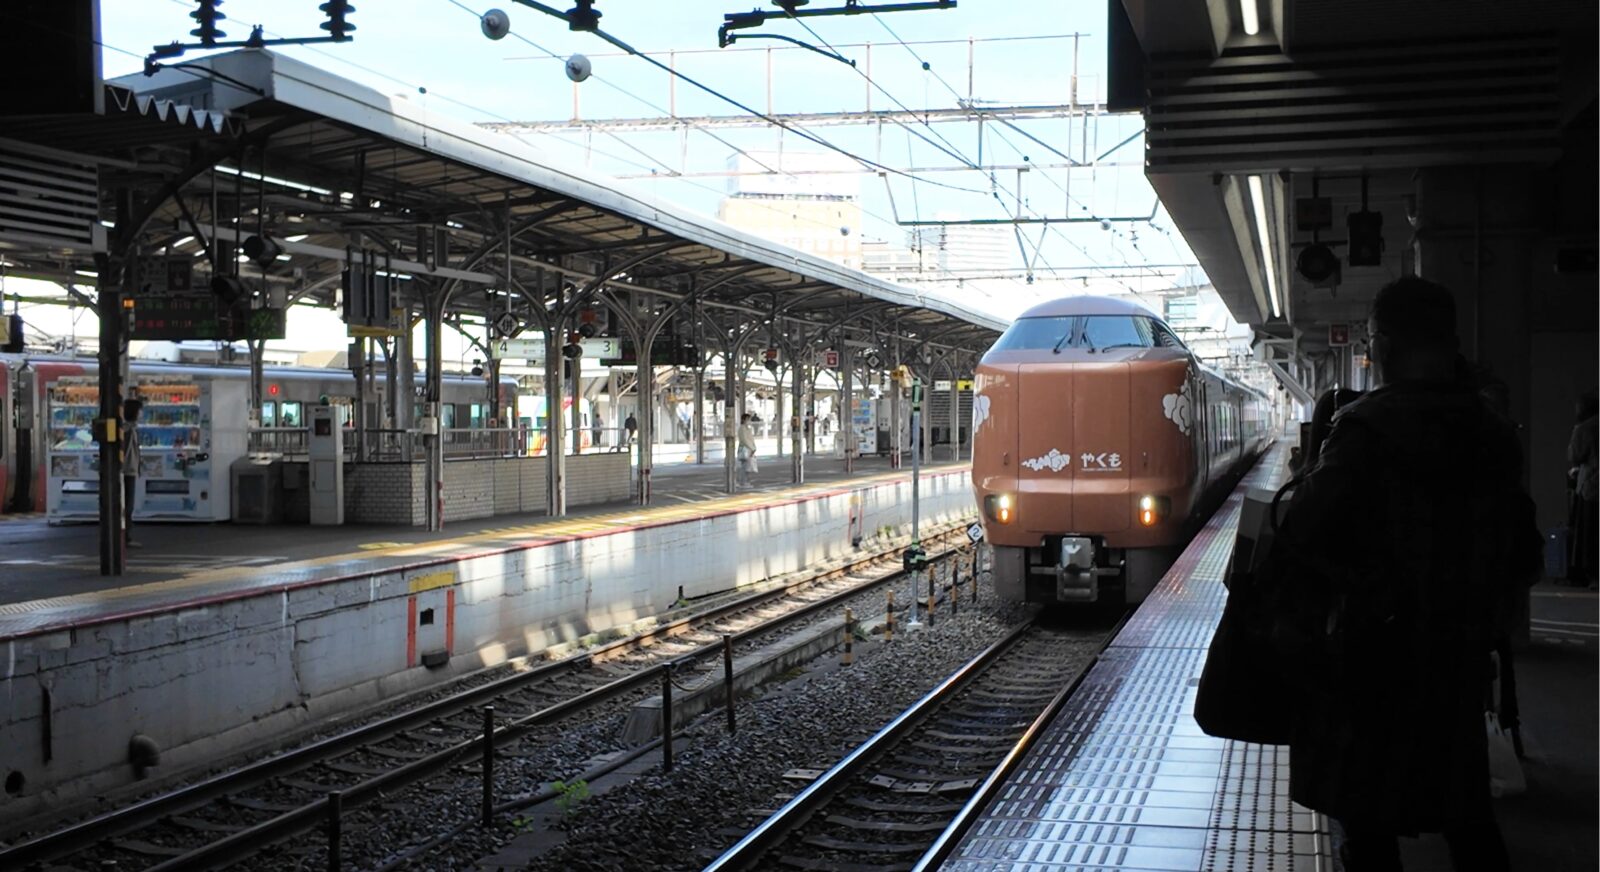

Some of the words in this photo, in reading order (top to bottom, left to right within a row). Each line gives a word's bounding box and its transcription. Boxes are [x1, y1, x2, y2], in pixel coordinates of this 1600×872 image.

[499, 341, 508, 352] 4
[603, 341, 611, 352] 3
[1081, 453, 1121, 467] やくも
[972, 527, 980, 538] 2
